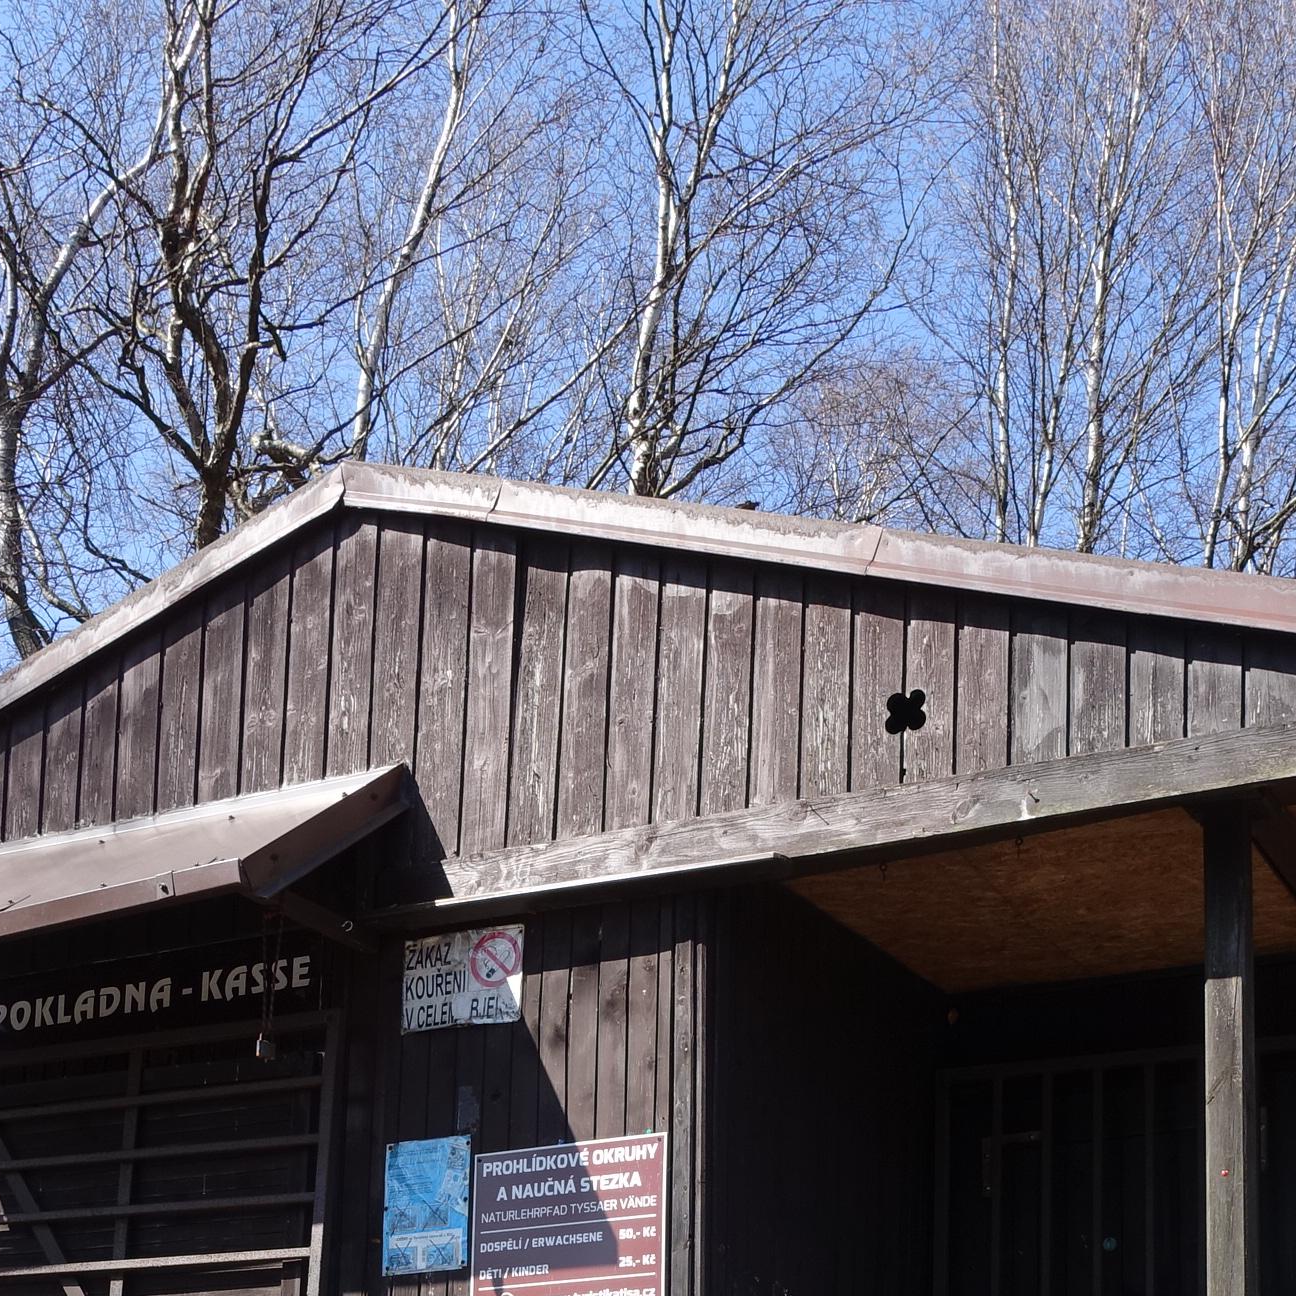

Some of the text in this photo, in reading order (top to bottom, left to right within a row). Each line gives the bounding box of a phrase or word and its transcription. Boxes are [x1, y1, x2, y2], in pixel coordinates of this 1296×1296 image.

[201, 955, 311, 1002] KASSE
[405, 964, 467, 1001] KOUŘENÍ
[405, 1007, 415, 1030] V
[482, 1143, 658, 1178] PROHLÍDKOVÉ OKRUHY
[496, 1171, 642, 1202] A NAUČNÁ STEZKA
[481, 1195, 657, 1224] NATURLEHRPFAD TYSSAER VÄNDE
[480, 1237, 523, 1253] DOSPĚLÍ
[531, 1231, 604, 1249] ERWACHSENE
[618, 1226, 657, 1240] 50,- Kč
[478, 1268, 502, 1281] DĚTI
[511, 1263, 550, 1278] KINDER
[618, 1254, 657, 1268] 25,- Kč
